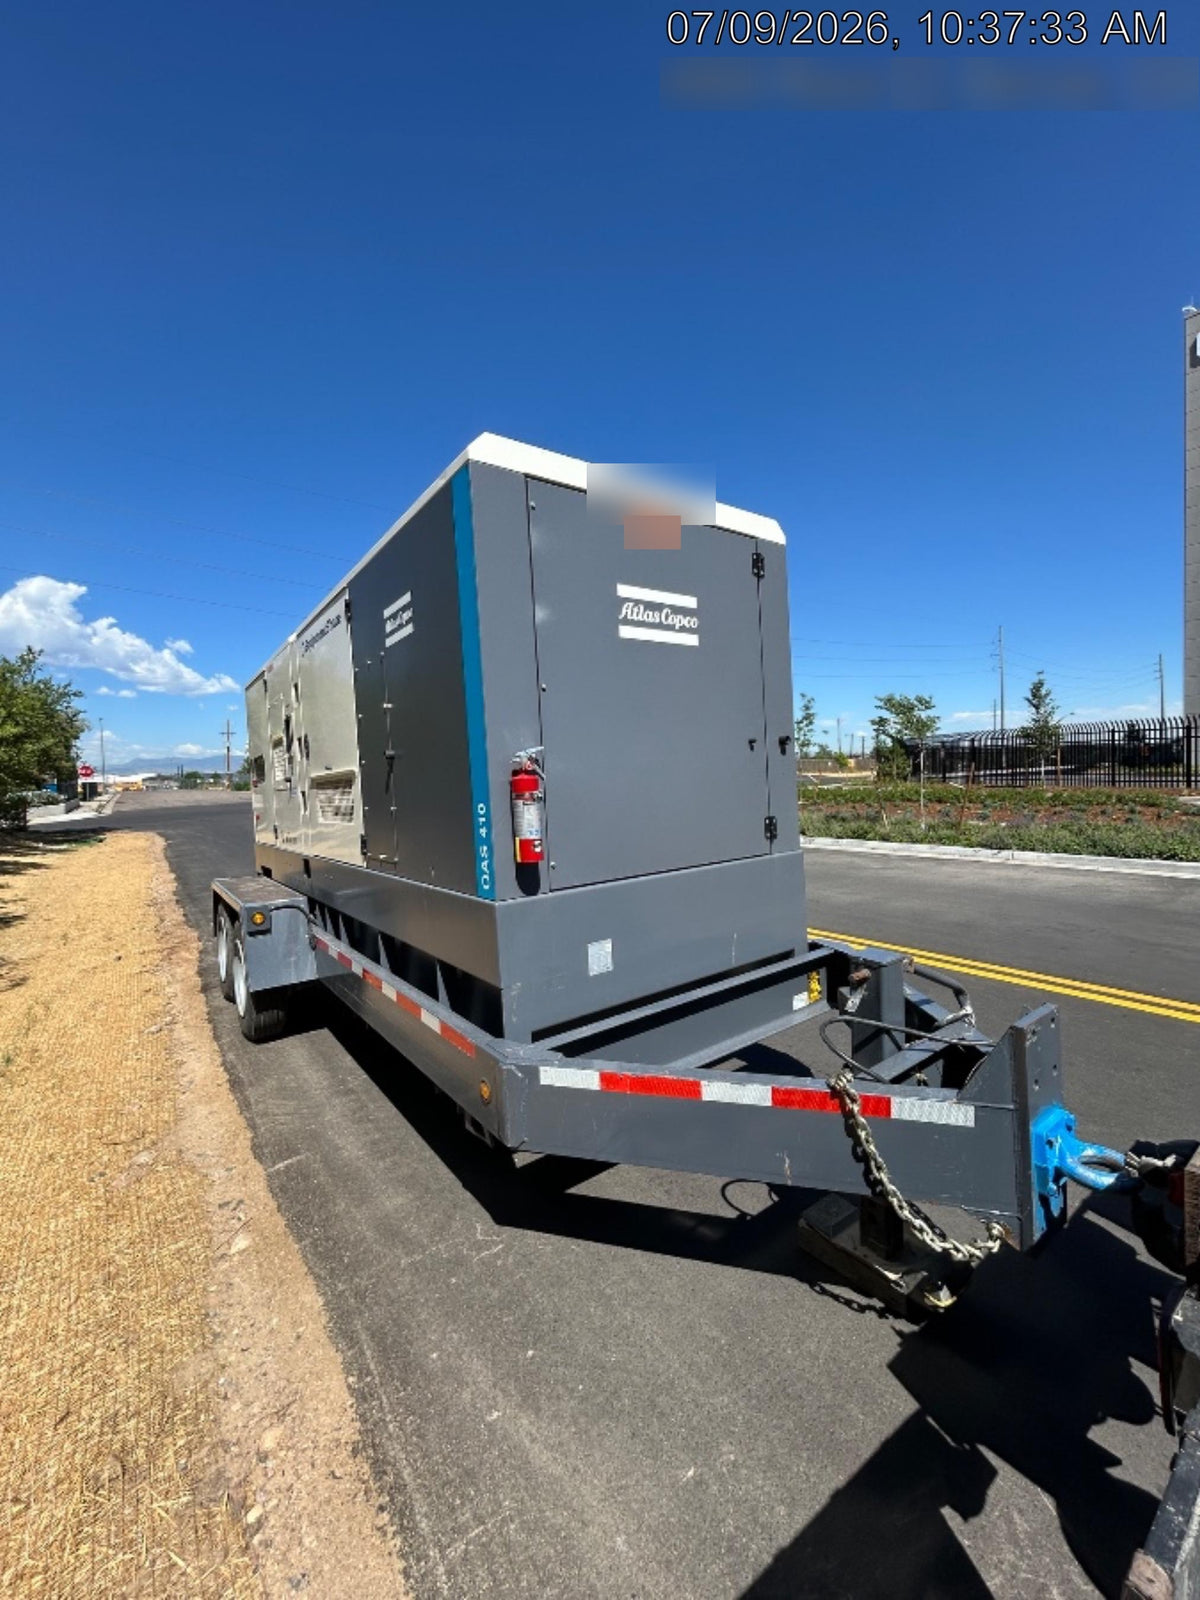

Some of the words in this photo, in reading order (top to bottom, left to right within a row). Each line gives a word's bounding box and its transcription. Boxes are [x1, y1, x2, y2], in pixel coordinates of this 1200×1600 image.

[618, 601, 661, 623] Atlas
[660, 607, 699, 630] Copco
[477, 802, 488, 839] 410
